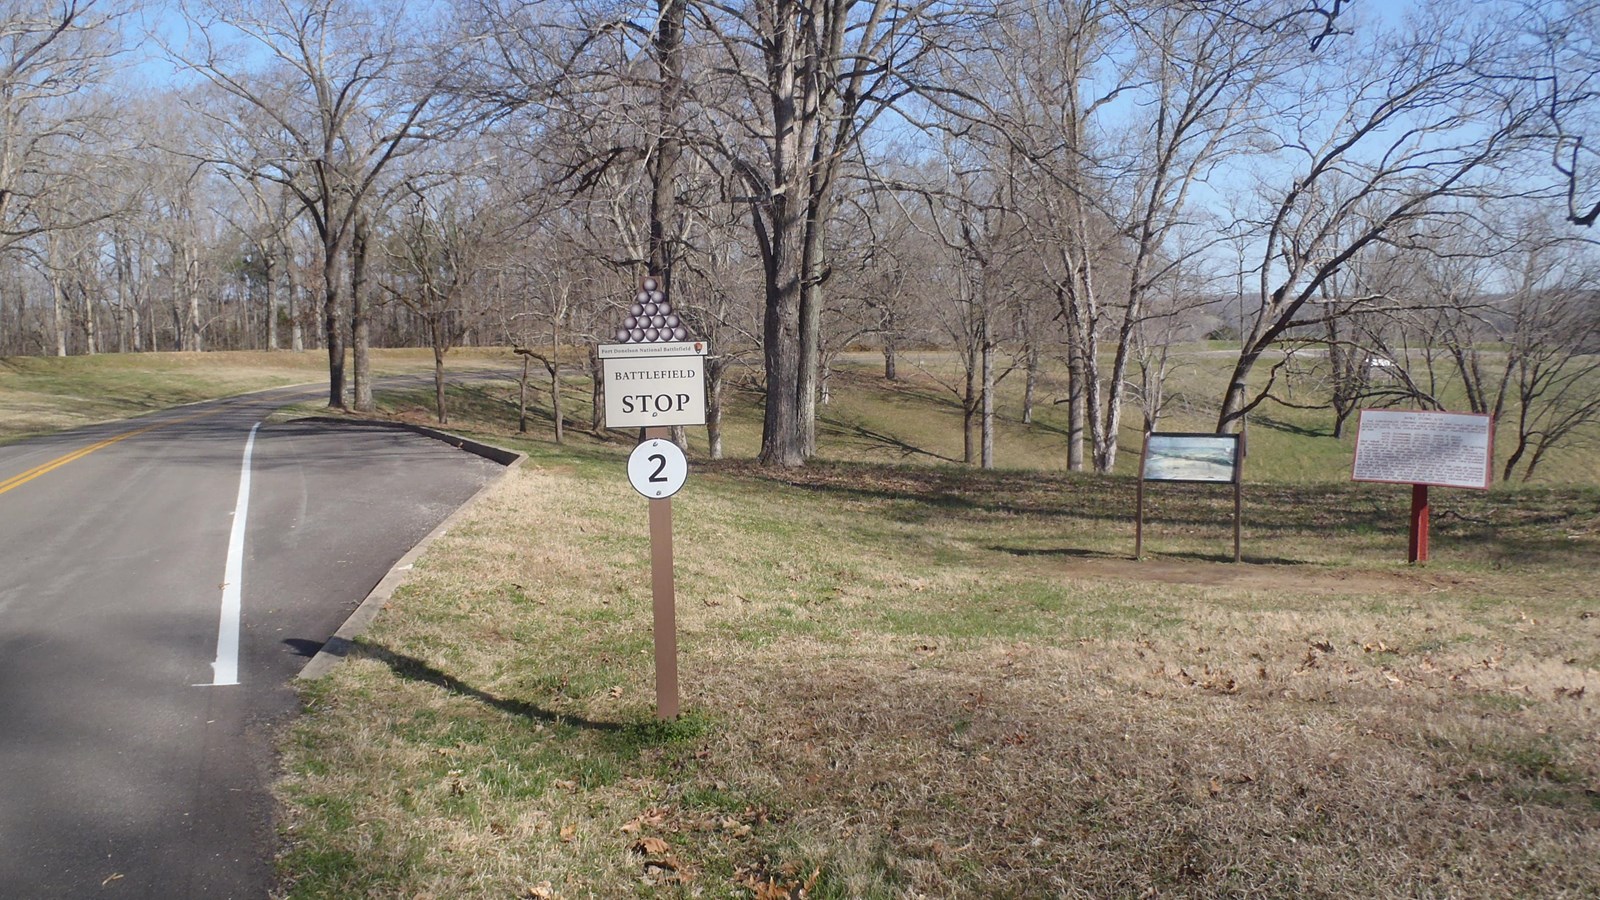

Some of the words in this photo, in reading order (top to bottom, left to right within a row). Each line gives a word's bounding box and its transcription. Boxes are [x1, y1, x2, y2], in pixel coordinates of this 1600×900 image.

[615, 370, 695, 381] BATTLEFIELD
[622, 394, 690, 413] STOP
[647, 454, 668, 483] 2
